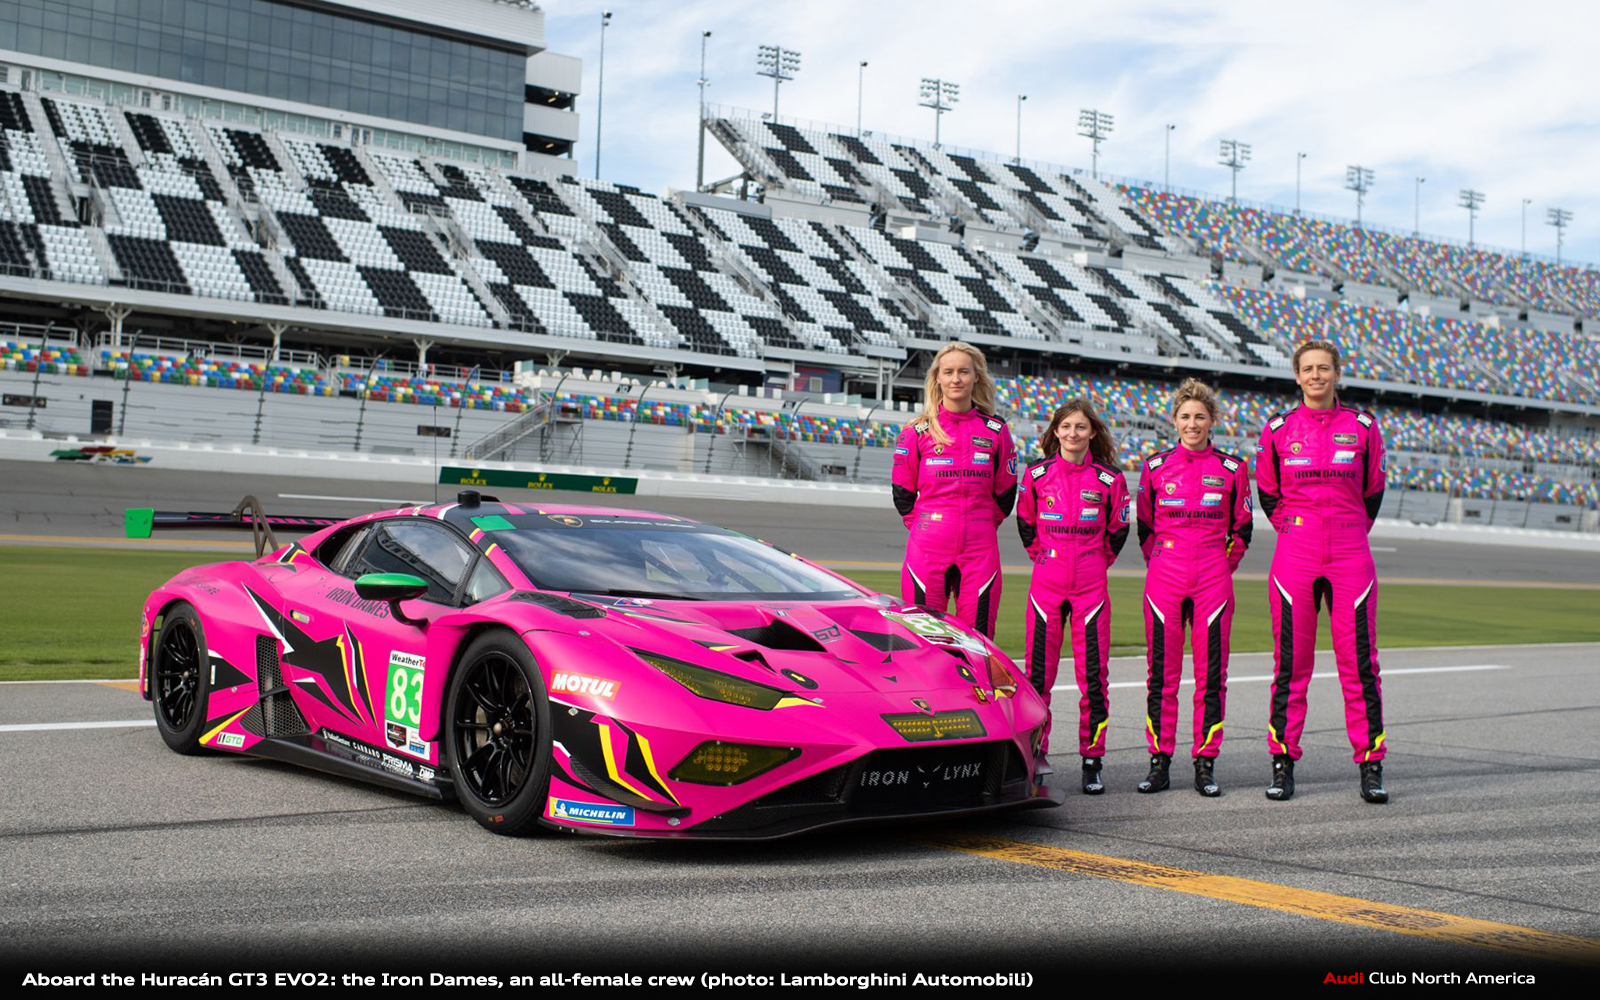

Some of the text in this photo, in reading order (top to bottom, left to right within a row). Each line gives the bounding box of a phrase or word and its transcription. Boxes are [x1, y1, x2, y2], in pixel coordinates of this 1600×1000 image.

[935, 468, 991, 479] IRON DAMES
[1294, 468, 1356, 479] IRON DAMES
[460, 478, 487, 486] ROLEX
[527, 481, 553, 489] ROLEX
[592, 485, 617, 493] ROLEX
[325, 587, 390, 619] IRON DAMES
[552, 673, 615, 697] MOTUL
[391, 668, 424, 725] 83
[860, 762, 981, 786] IRON LYNX
[568, 807, 626, 820] MICHELIN
